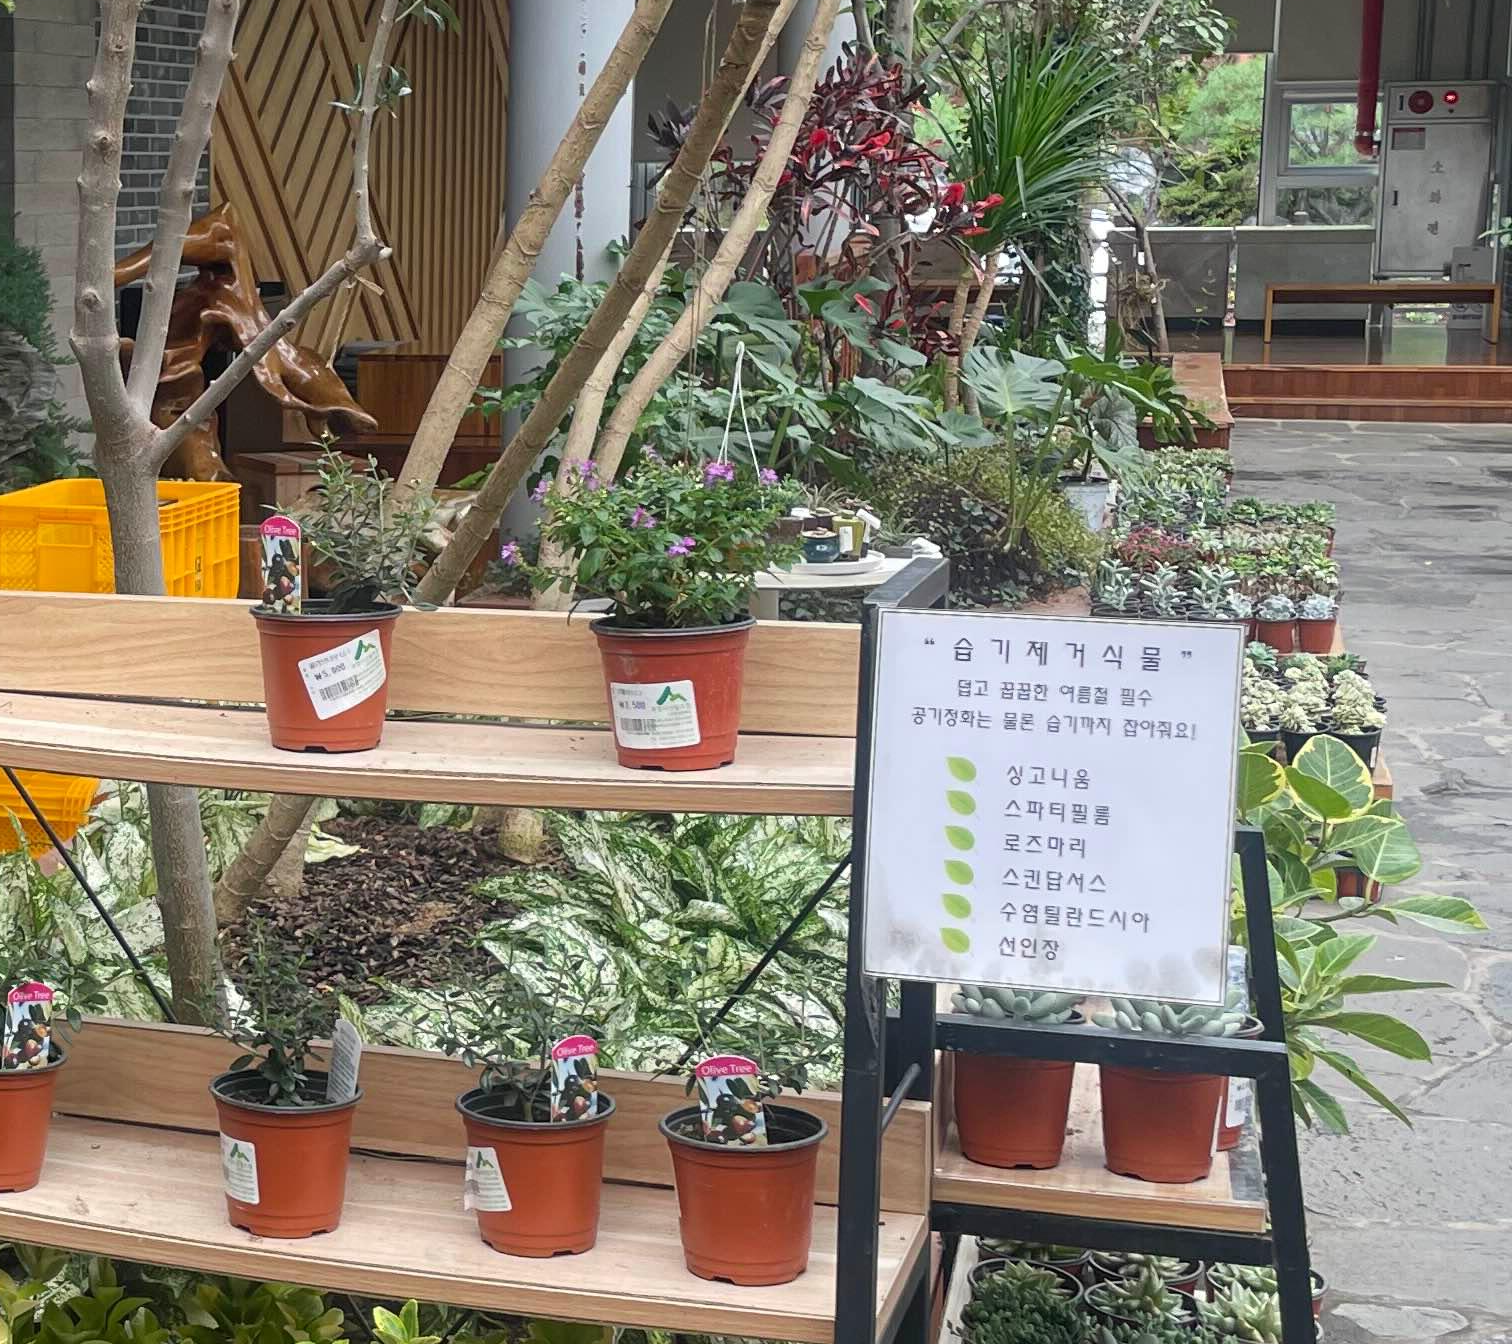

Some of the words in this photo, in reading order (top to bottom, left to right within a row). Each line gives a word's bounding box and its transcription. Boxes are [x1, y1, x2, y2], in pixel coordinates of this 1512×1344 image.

[958, 679, 989, 697] 덥고
[1000, 682, 1048, 702] 꿉꿉한
[1059, 685, 1108, 705] 여름철
[1121, 688, 1153, 707] 필수
[912, 707, 992, 729] 공기정화는
[1003, 712, 1035, 731] 물론
[1047, 715, 1111, 736] 습기까지
[1123, 719, 1196, 741] 잡아줘요!
[1007, 765, 1090, 790] 싱고니움
[1004, 799, 1111, 825] 스파티필름
[1003, 833, 1086, 858] 로즈마리
[1002, 868, 1106, 893] 스킨답서스
[1000, 902, 1150, 933] 수염틸란드시아
[999, 936, 1059, 960] 선인장
[13, 991, 32, 1001] Olive
[34, 990, 50, 1000] Tree
[557, 1047, 577, 1057] Olive
[578, 1044, 595, 1054] Tree
[701, 1065, 728, 1075] Olive
[729, 1064, 753, 1074] Tree
